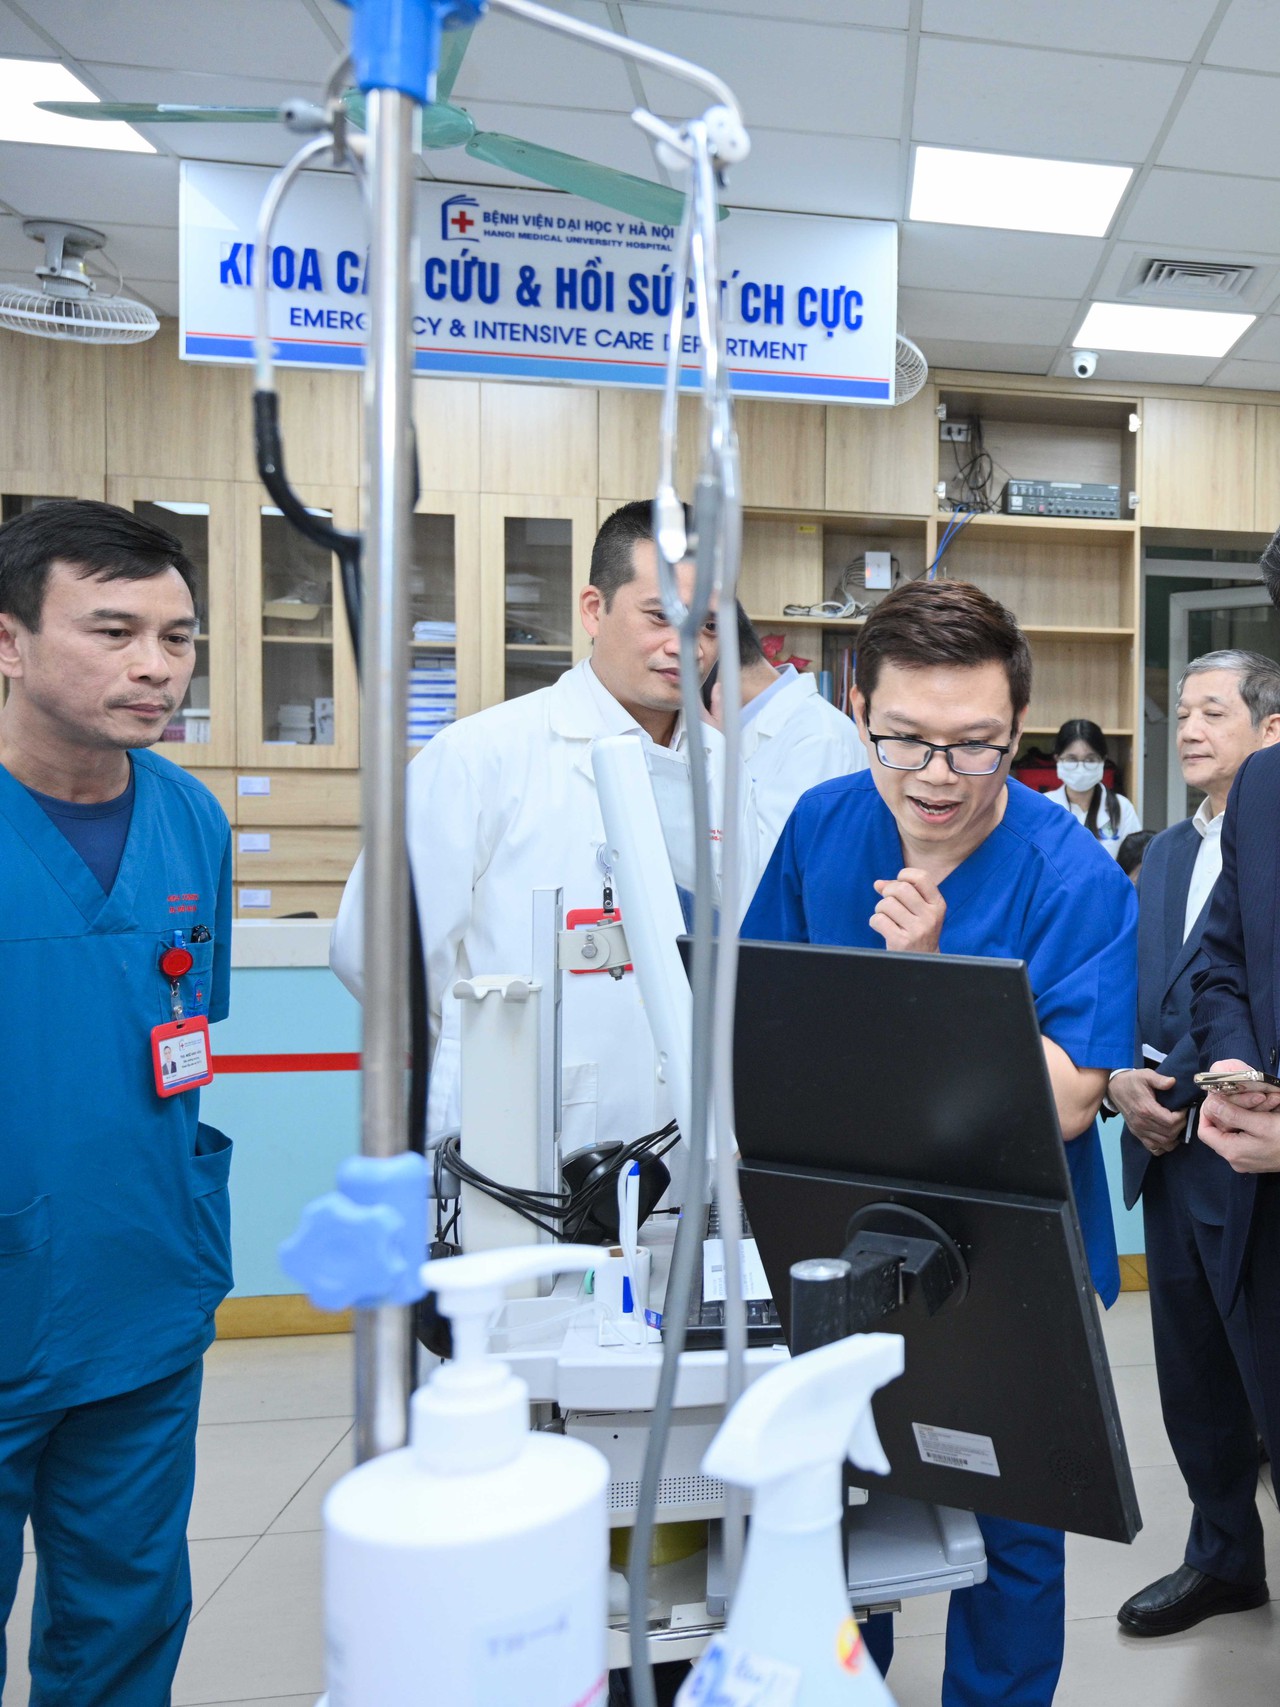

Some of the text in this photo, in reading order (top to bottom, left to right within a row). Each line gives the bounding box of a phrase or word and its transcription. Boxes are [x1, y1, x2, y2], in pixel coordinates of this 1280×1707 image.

[483, 209, 519, 227] BỆNH
[522, 213, 554, 230] VIỆN
[584, 220, 613, 235] HỌC
[616, 222, 625, 235] Y
[629, 221, 648, 237] HÀ
[651, 224, 675, 241] NỘI
[483, 229, 673, 253] HANOI MEDICAL UNIVERSITY HOSPITAL
[425, 248, 500, 305] CỨU
[516, 265, 542, 308] &
[556, 256, 614, 312] HỒI
[798, 285, 864, 338] CỰC
[290, 307, 808, 361] EMERGCY & INTENSIVE CARE EPRTMENT
